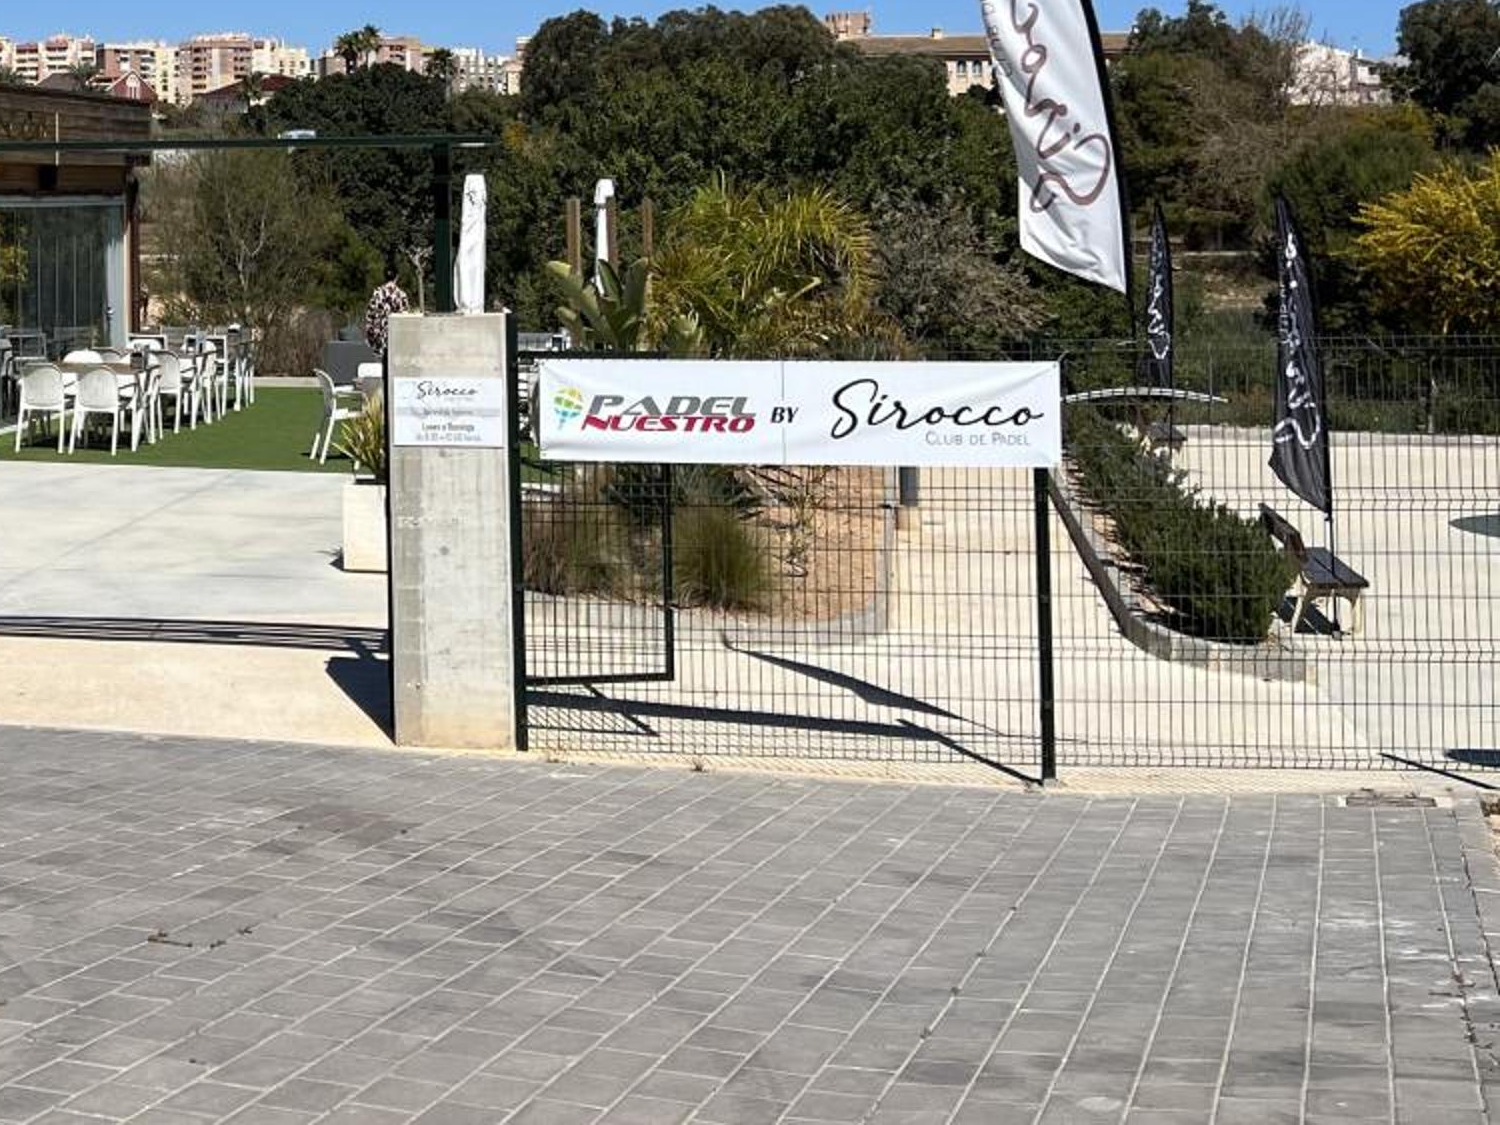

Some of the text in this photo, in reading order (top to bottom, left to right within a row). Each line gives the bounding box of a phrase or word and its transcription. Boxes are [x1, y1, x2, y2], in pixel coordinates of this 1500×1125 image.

[416, 380, 479, 400] Sirocco
[590, 394, 757, 417] PADEL
[770, 378, 1045, 440] BY Sirocco
[581, 414, 757, 434] NUESTRO
